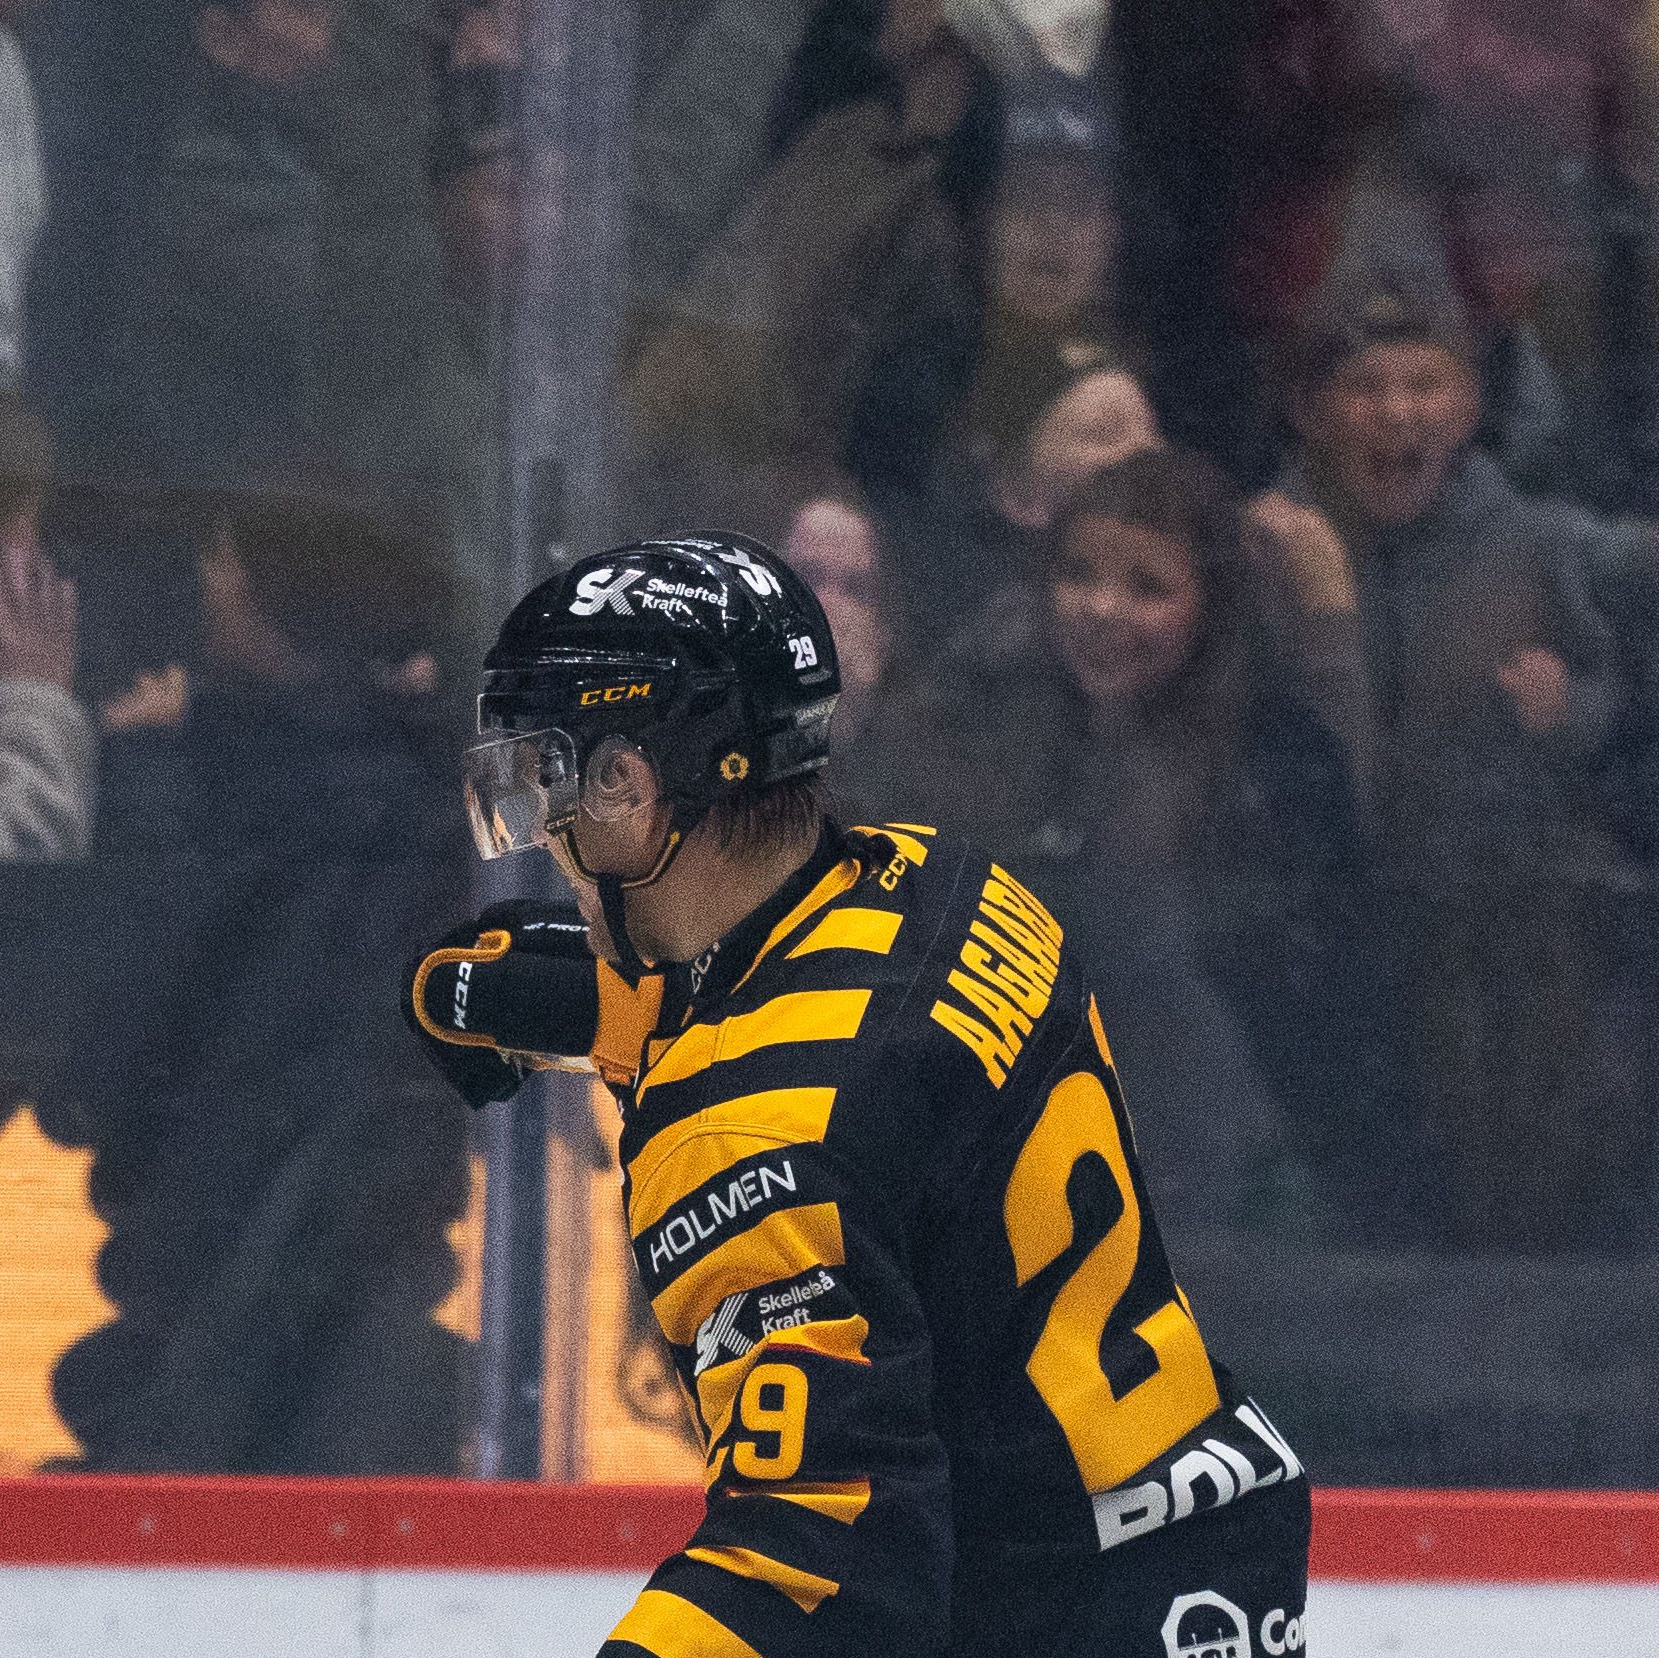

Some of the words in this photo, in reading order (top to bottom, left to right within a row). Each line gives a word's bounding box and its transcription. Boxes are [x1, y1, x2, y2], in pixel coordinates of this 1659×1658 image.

[641, 593, 684, 614] Kraft
[788, 636, 818, 670] 29
[579, 682, 652, 708] CCM
[649, 1160, 797, 1273] HOLMEN
[1004, 1072, 1220, 1494] 2
[730, 1363, 809, 1479] 9
